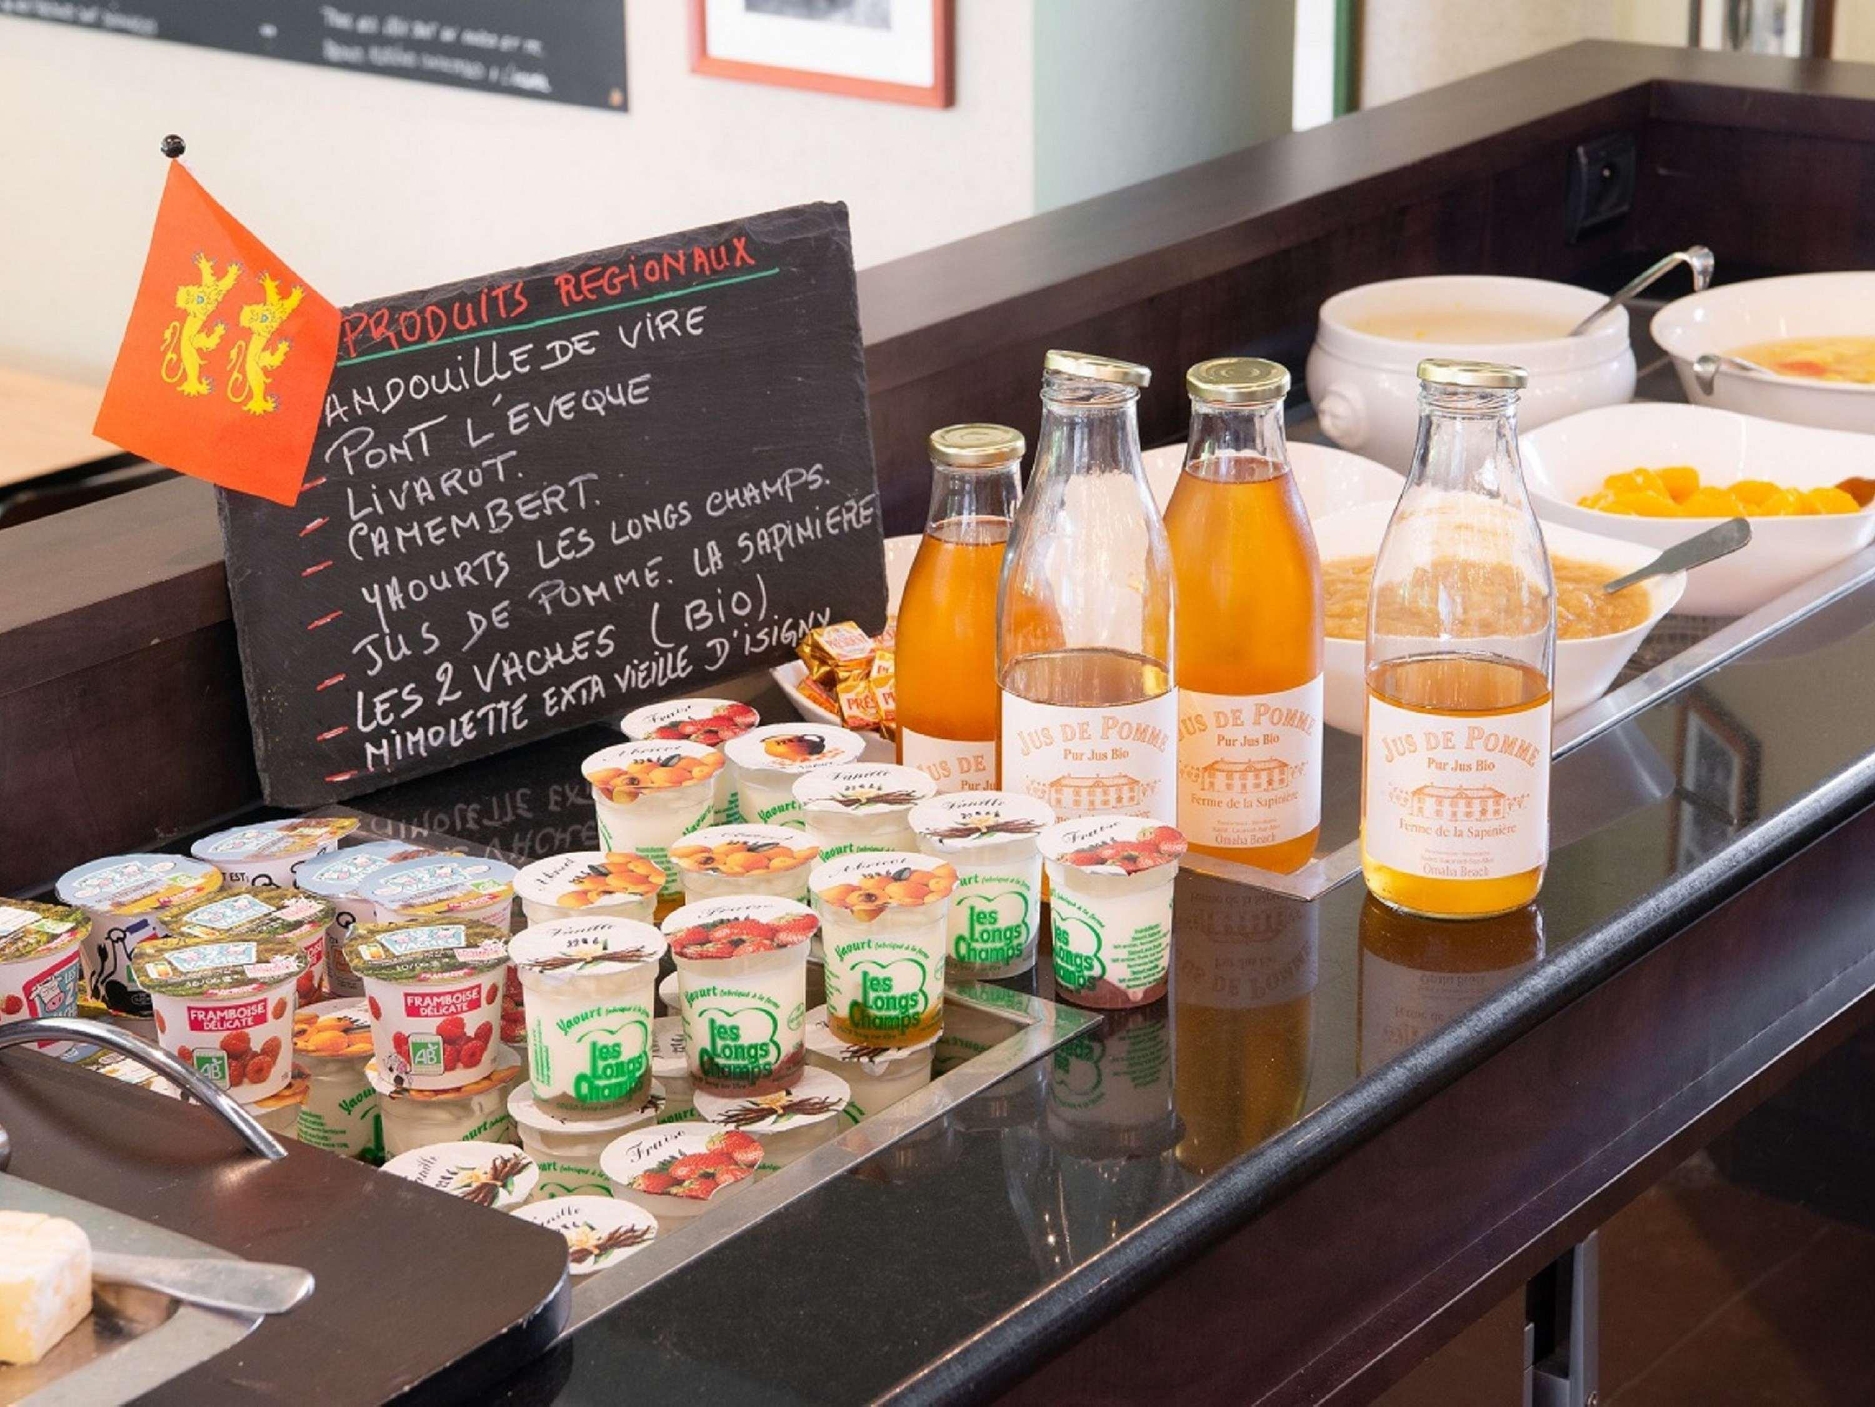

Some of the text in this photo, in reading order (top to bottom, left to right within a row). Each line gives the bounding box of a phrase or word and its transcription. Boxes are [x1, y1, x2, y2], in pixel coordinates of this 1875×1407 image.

[539, 330, 600, 367] DE
[361, 548, 511, 632] YAOURTS
[536, 525, 597, 571] LES
[610, 503, 693, 547] LONGS
[351, 621, 442, 678] JUS
[461, 599, 511, 653] DE
[692, 541, 724, 579] LA
[355, 682, 424, 735] LES
[436, 661, 469, 706] 2
[471, 623, 618, 695] VACHES
[1214, 708, 1245, 729] DE
[1252, 702, 1317, 737] POMME
[363, 697, 530, 776] MIMOLETTE
[1017, 715, 1170, 757] JUS DE POMME
[1216, 733, 1281, 747] Pur Jus Bio
[1381, 725, 1541, 768] JUS DE POMME
[1063, 747, 1131, 762] Pur Jus Bio
[1427, 757, 1497, 772] Pur Jus Bio
[1399, 818, 1433, 835] Ferme
[1435, 824, 1451, 838] de
[1453, 825, 1464, 839] la
[190, 1003, 267, 1021] FRAMBOISE
[407, 988, 481, 1008] FRAMBOISE
[419, 1002, 470, 1017] DÉLICATE
[203, 1015, 256, 1031] DÉLICATE
[556, 1006, 602, 1037] Yaourt
